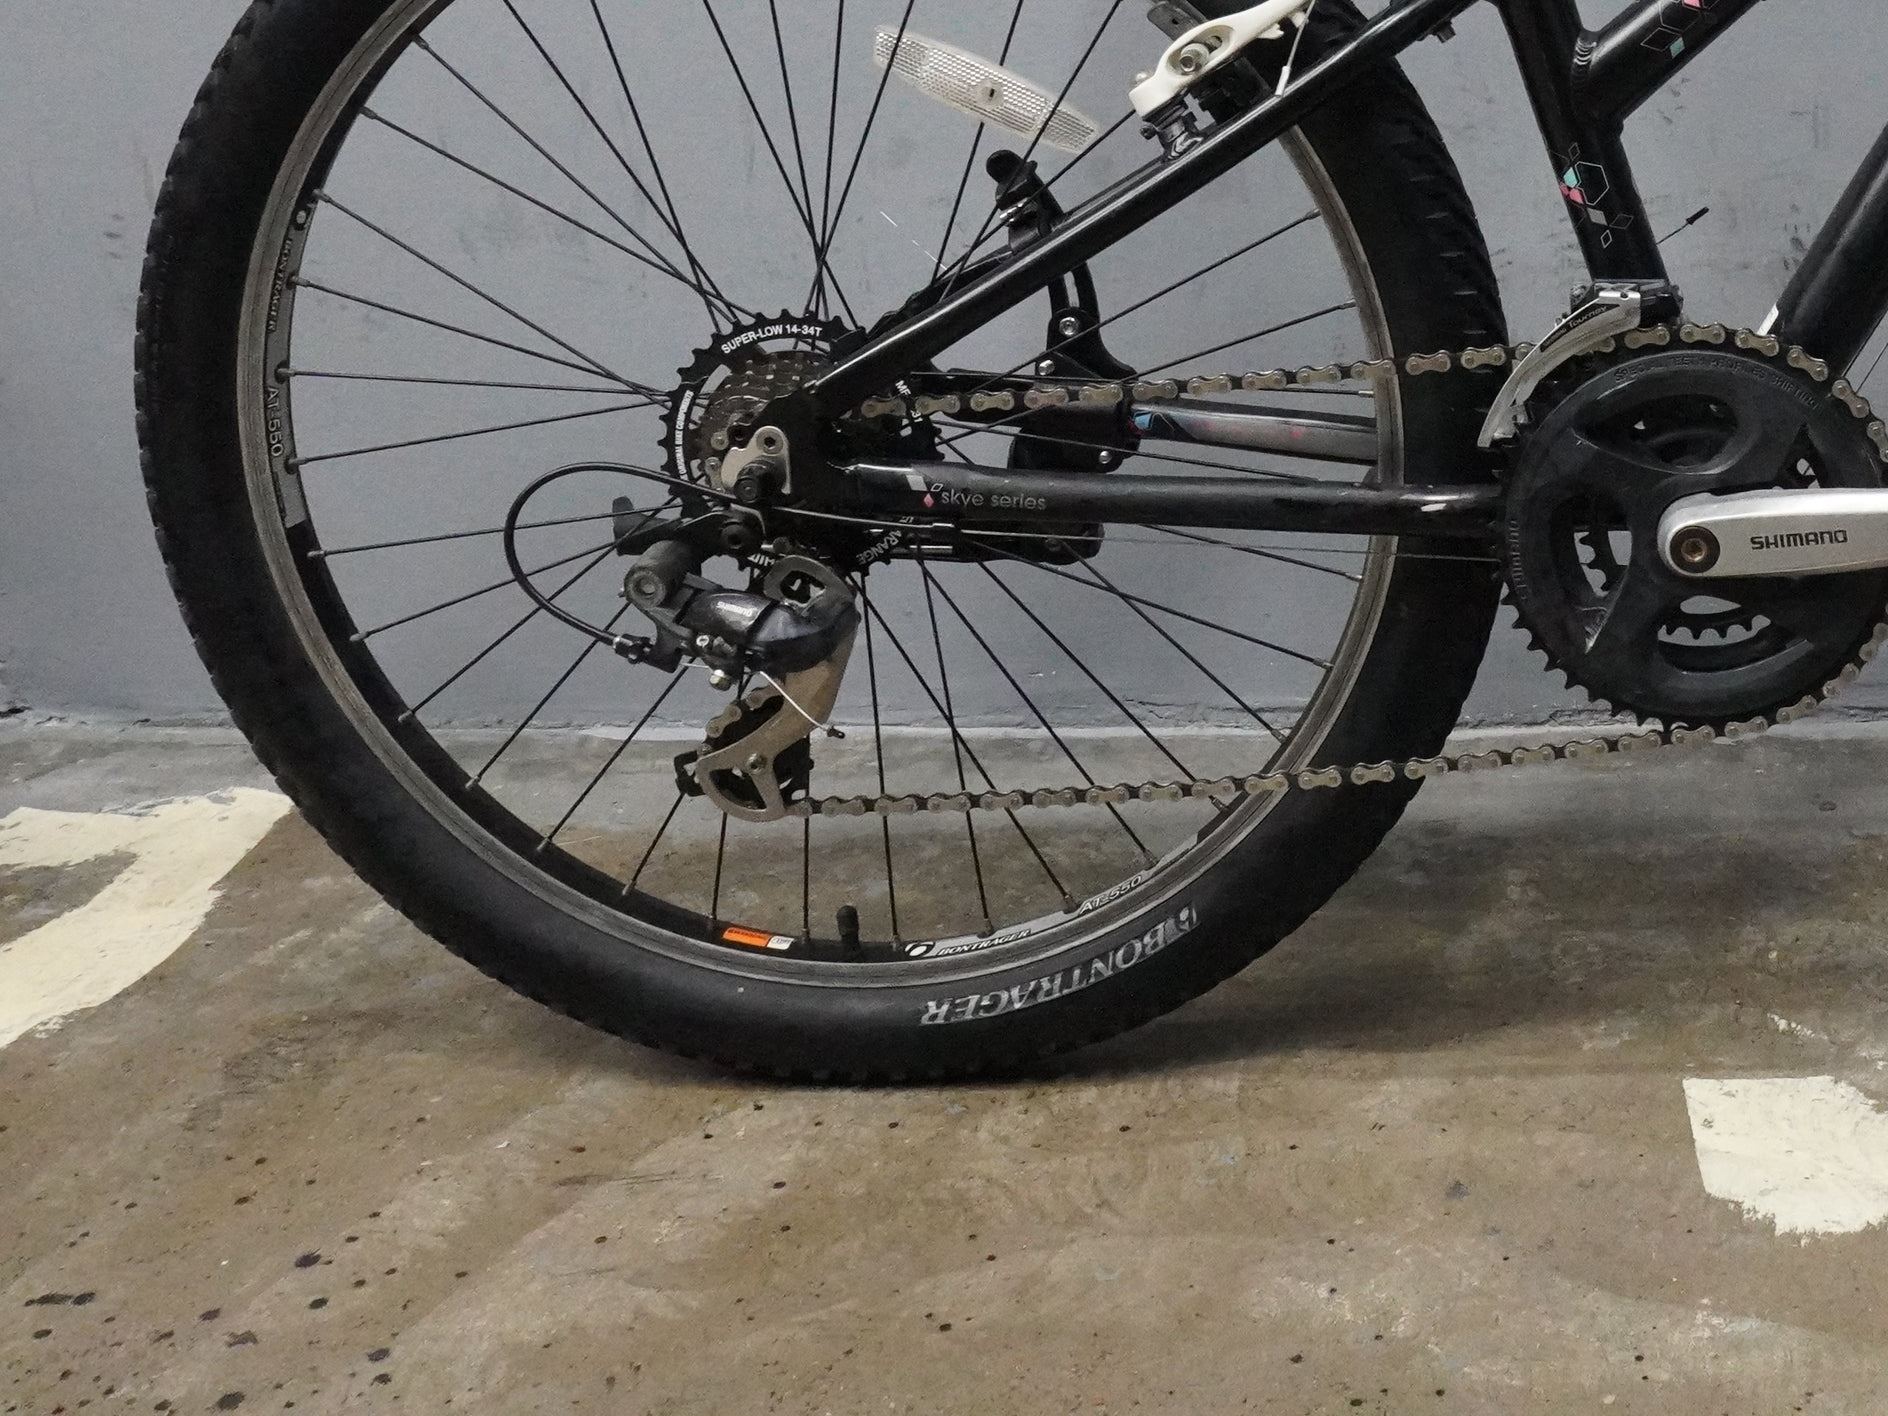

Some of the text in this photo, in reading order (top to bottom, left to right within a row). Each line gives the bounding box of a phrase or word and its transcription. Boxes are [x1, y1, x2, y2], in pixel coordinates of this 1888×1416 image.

[721, 324, 823, 354] SUPER-LOW 14-34T
[267, 387, 285, 457] AT-550
[941, 488, 1047, 510] skye series
[1750, 529, 1848, 550] SHIMANO
[1079, 874, 1144, 916] AT-550
[937, 929, 1032, 957] BONTRAGER
[919, 918, 1168, 1026] BONTRAGER
